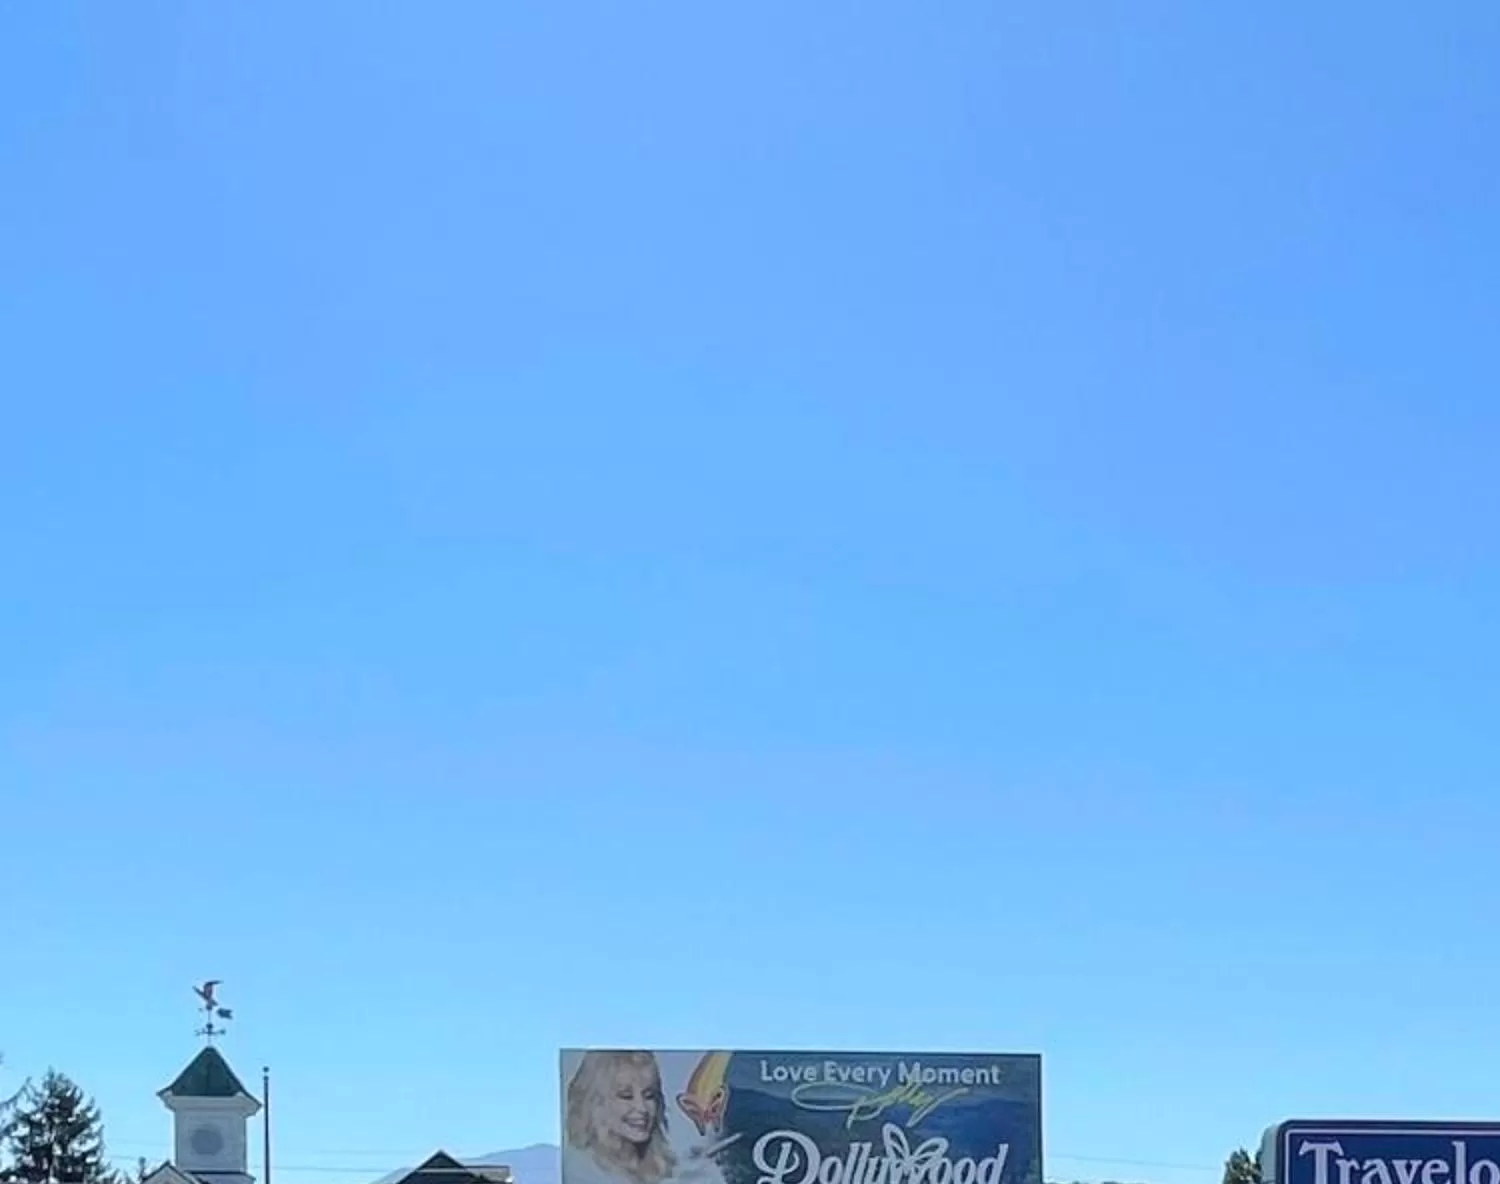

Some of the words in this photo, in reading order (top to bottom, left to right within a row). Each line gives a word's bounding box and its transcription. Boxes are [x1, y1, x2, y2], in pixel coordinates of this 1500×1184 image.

[760, 1060, 817, 1082] Love
[823, 1062, 891, 1086] Every
[899, 1062, 1001, 1084] Moment
